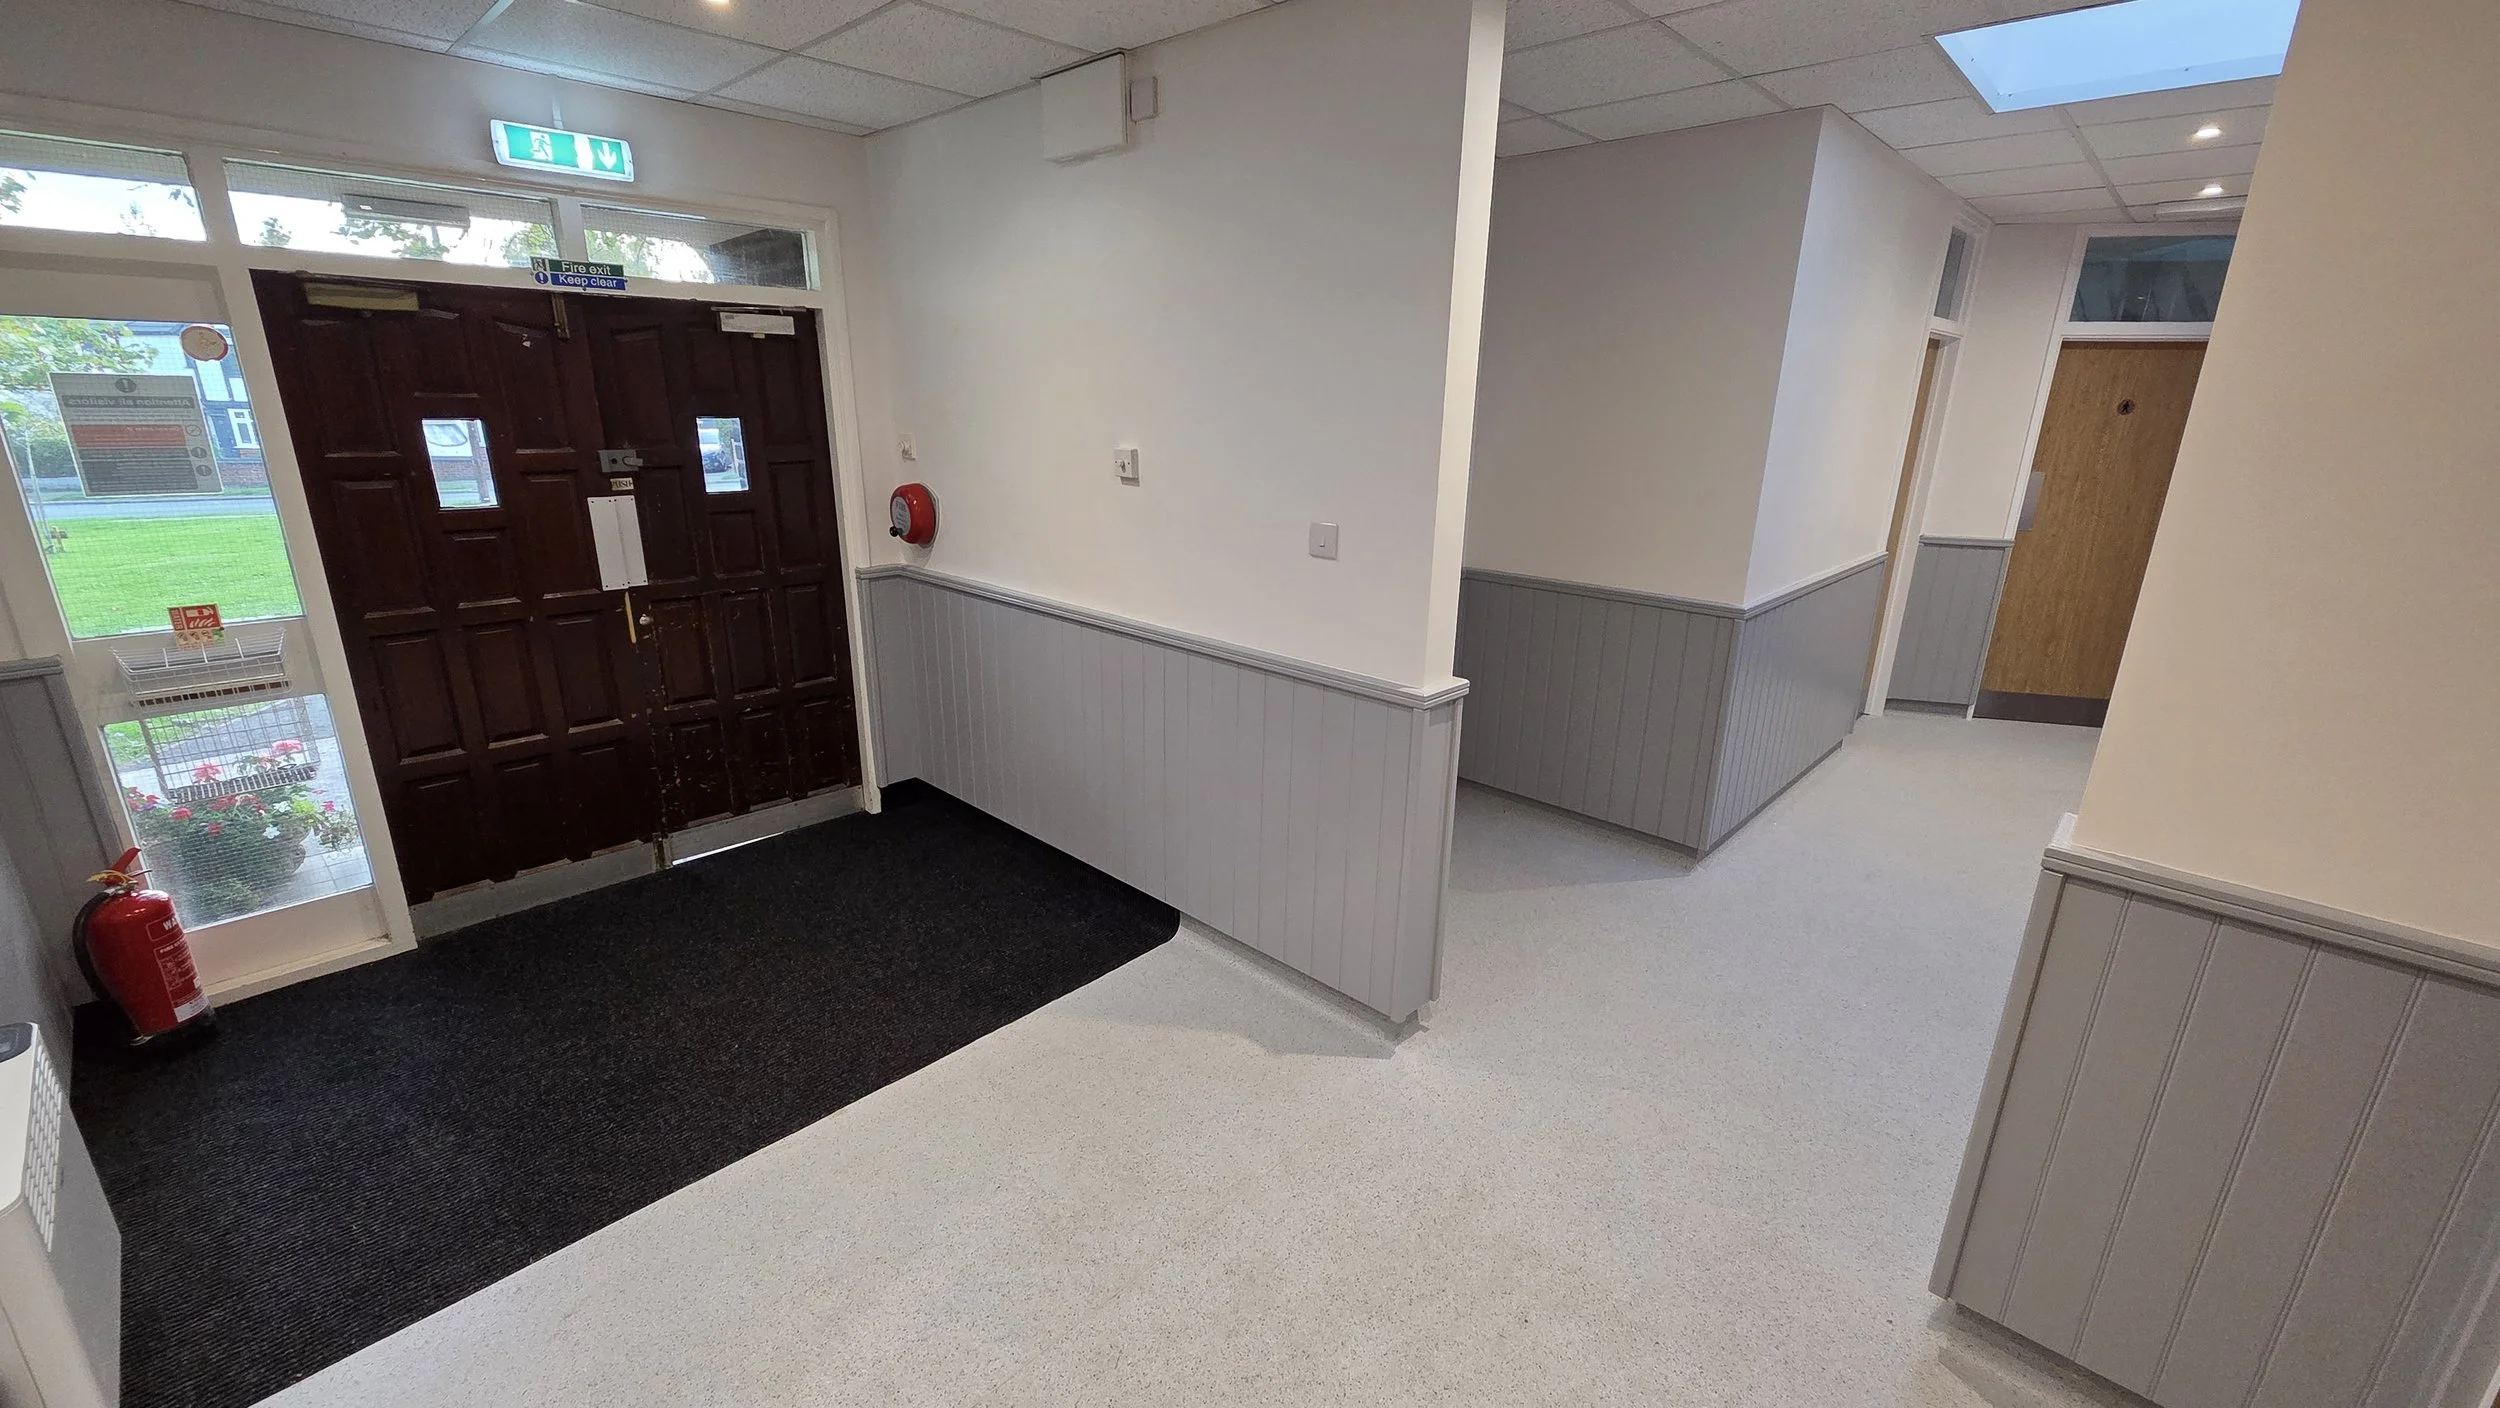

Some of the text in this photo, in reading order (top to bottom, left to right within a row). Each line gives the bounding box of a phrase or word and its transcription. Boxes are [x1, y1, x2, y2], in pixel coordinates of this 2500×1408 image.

[561, 261, 611, 276] Fire exit
[559, 274, 617, 287] Keep clear
